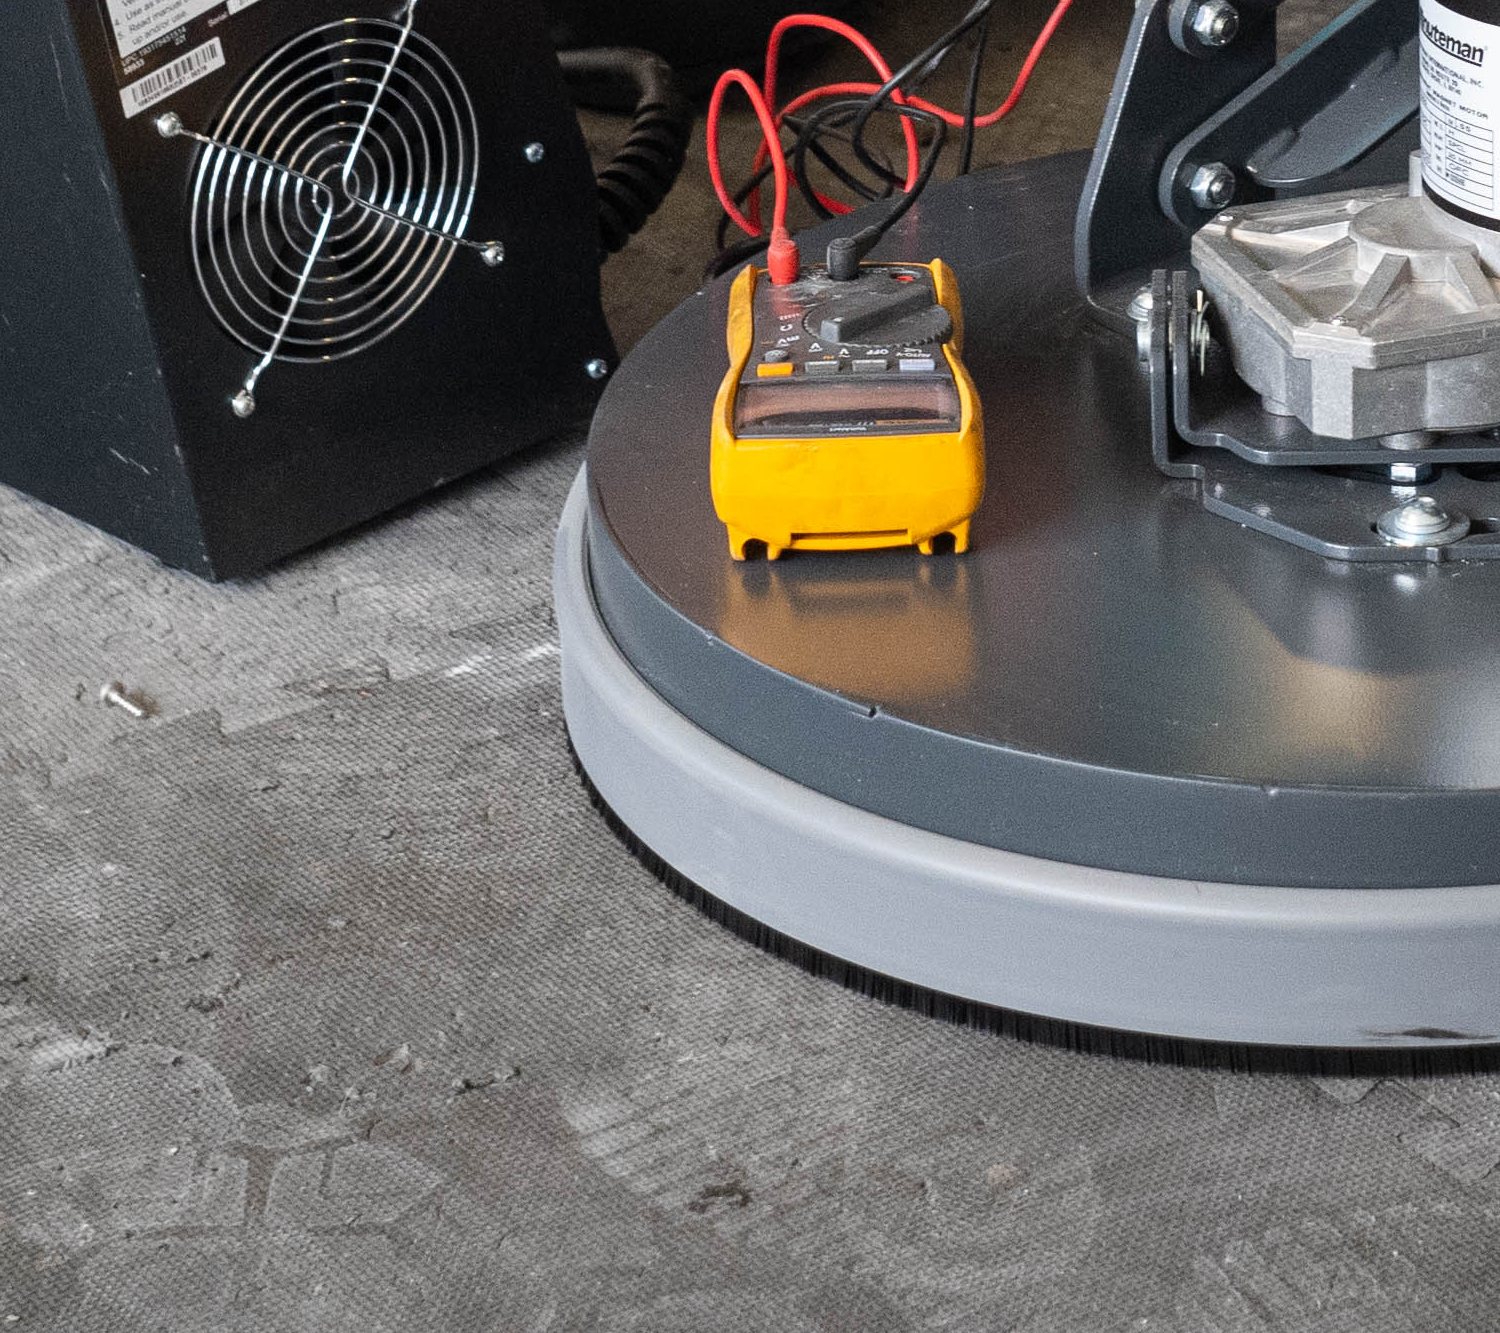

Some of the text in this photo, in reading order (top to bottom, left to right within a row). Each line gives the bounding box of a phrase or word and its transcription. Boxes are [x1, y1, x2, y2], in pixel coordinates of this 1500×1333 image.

[125, 8, 142, 20] Use
[144, 2, 154, 10] as
[129, 16, 151, 31] Read
